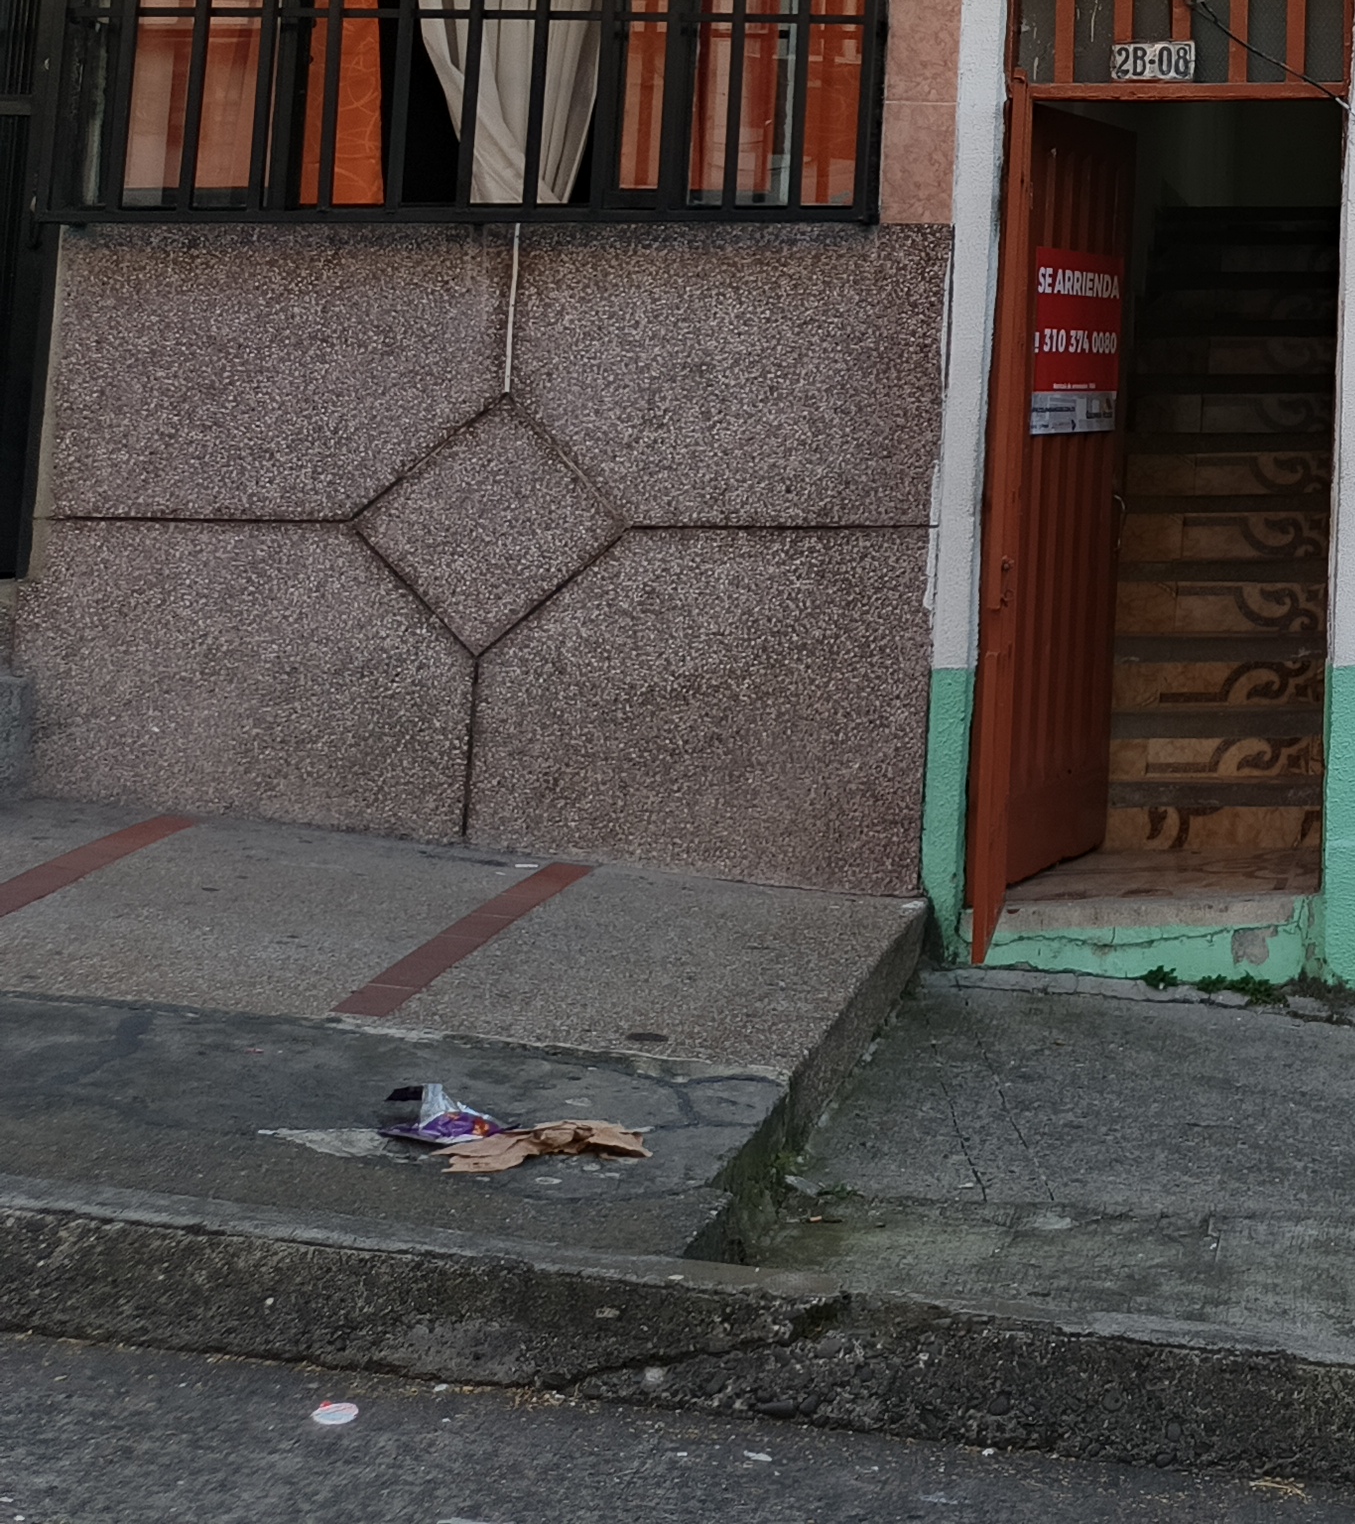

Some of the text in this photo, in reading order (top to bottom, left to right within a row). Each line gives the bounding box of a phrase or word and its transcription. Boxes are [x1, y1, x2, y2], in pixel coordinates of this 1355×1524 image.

[1115, 46, 1189, 78] 2B-08
[1038, 267, 1120, 299] SE ARRIENDA
[1043, 328, 1117, 354] 310 374 0080
